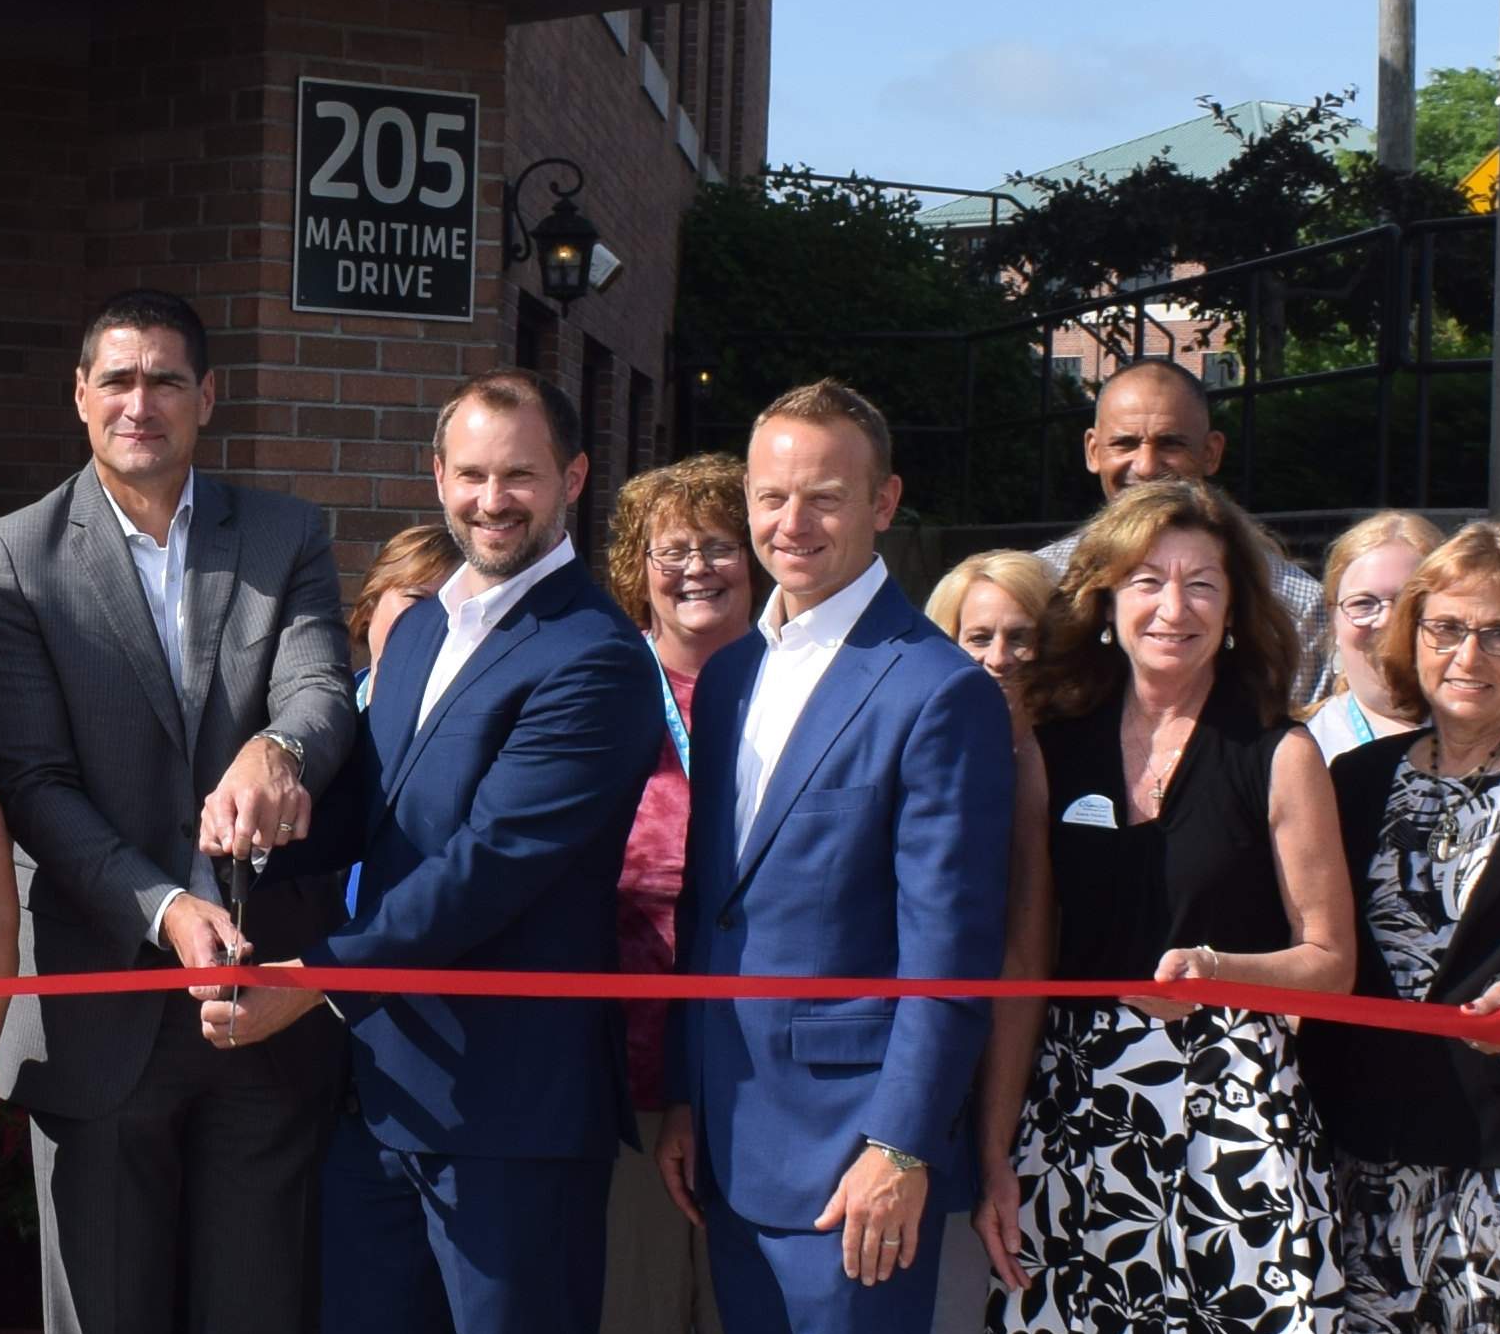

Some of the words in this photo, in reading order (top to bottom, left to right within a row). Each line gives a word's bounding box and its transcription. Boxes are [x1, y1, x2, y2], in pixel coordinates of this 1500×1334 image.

[308, 100, 466, 209] 205
[305, 216, 467, 261] MARITIME
[337, 260, 433, 299] DRIVE
